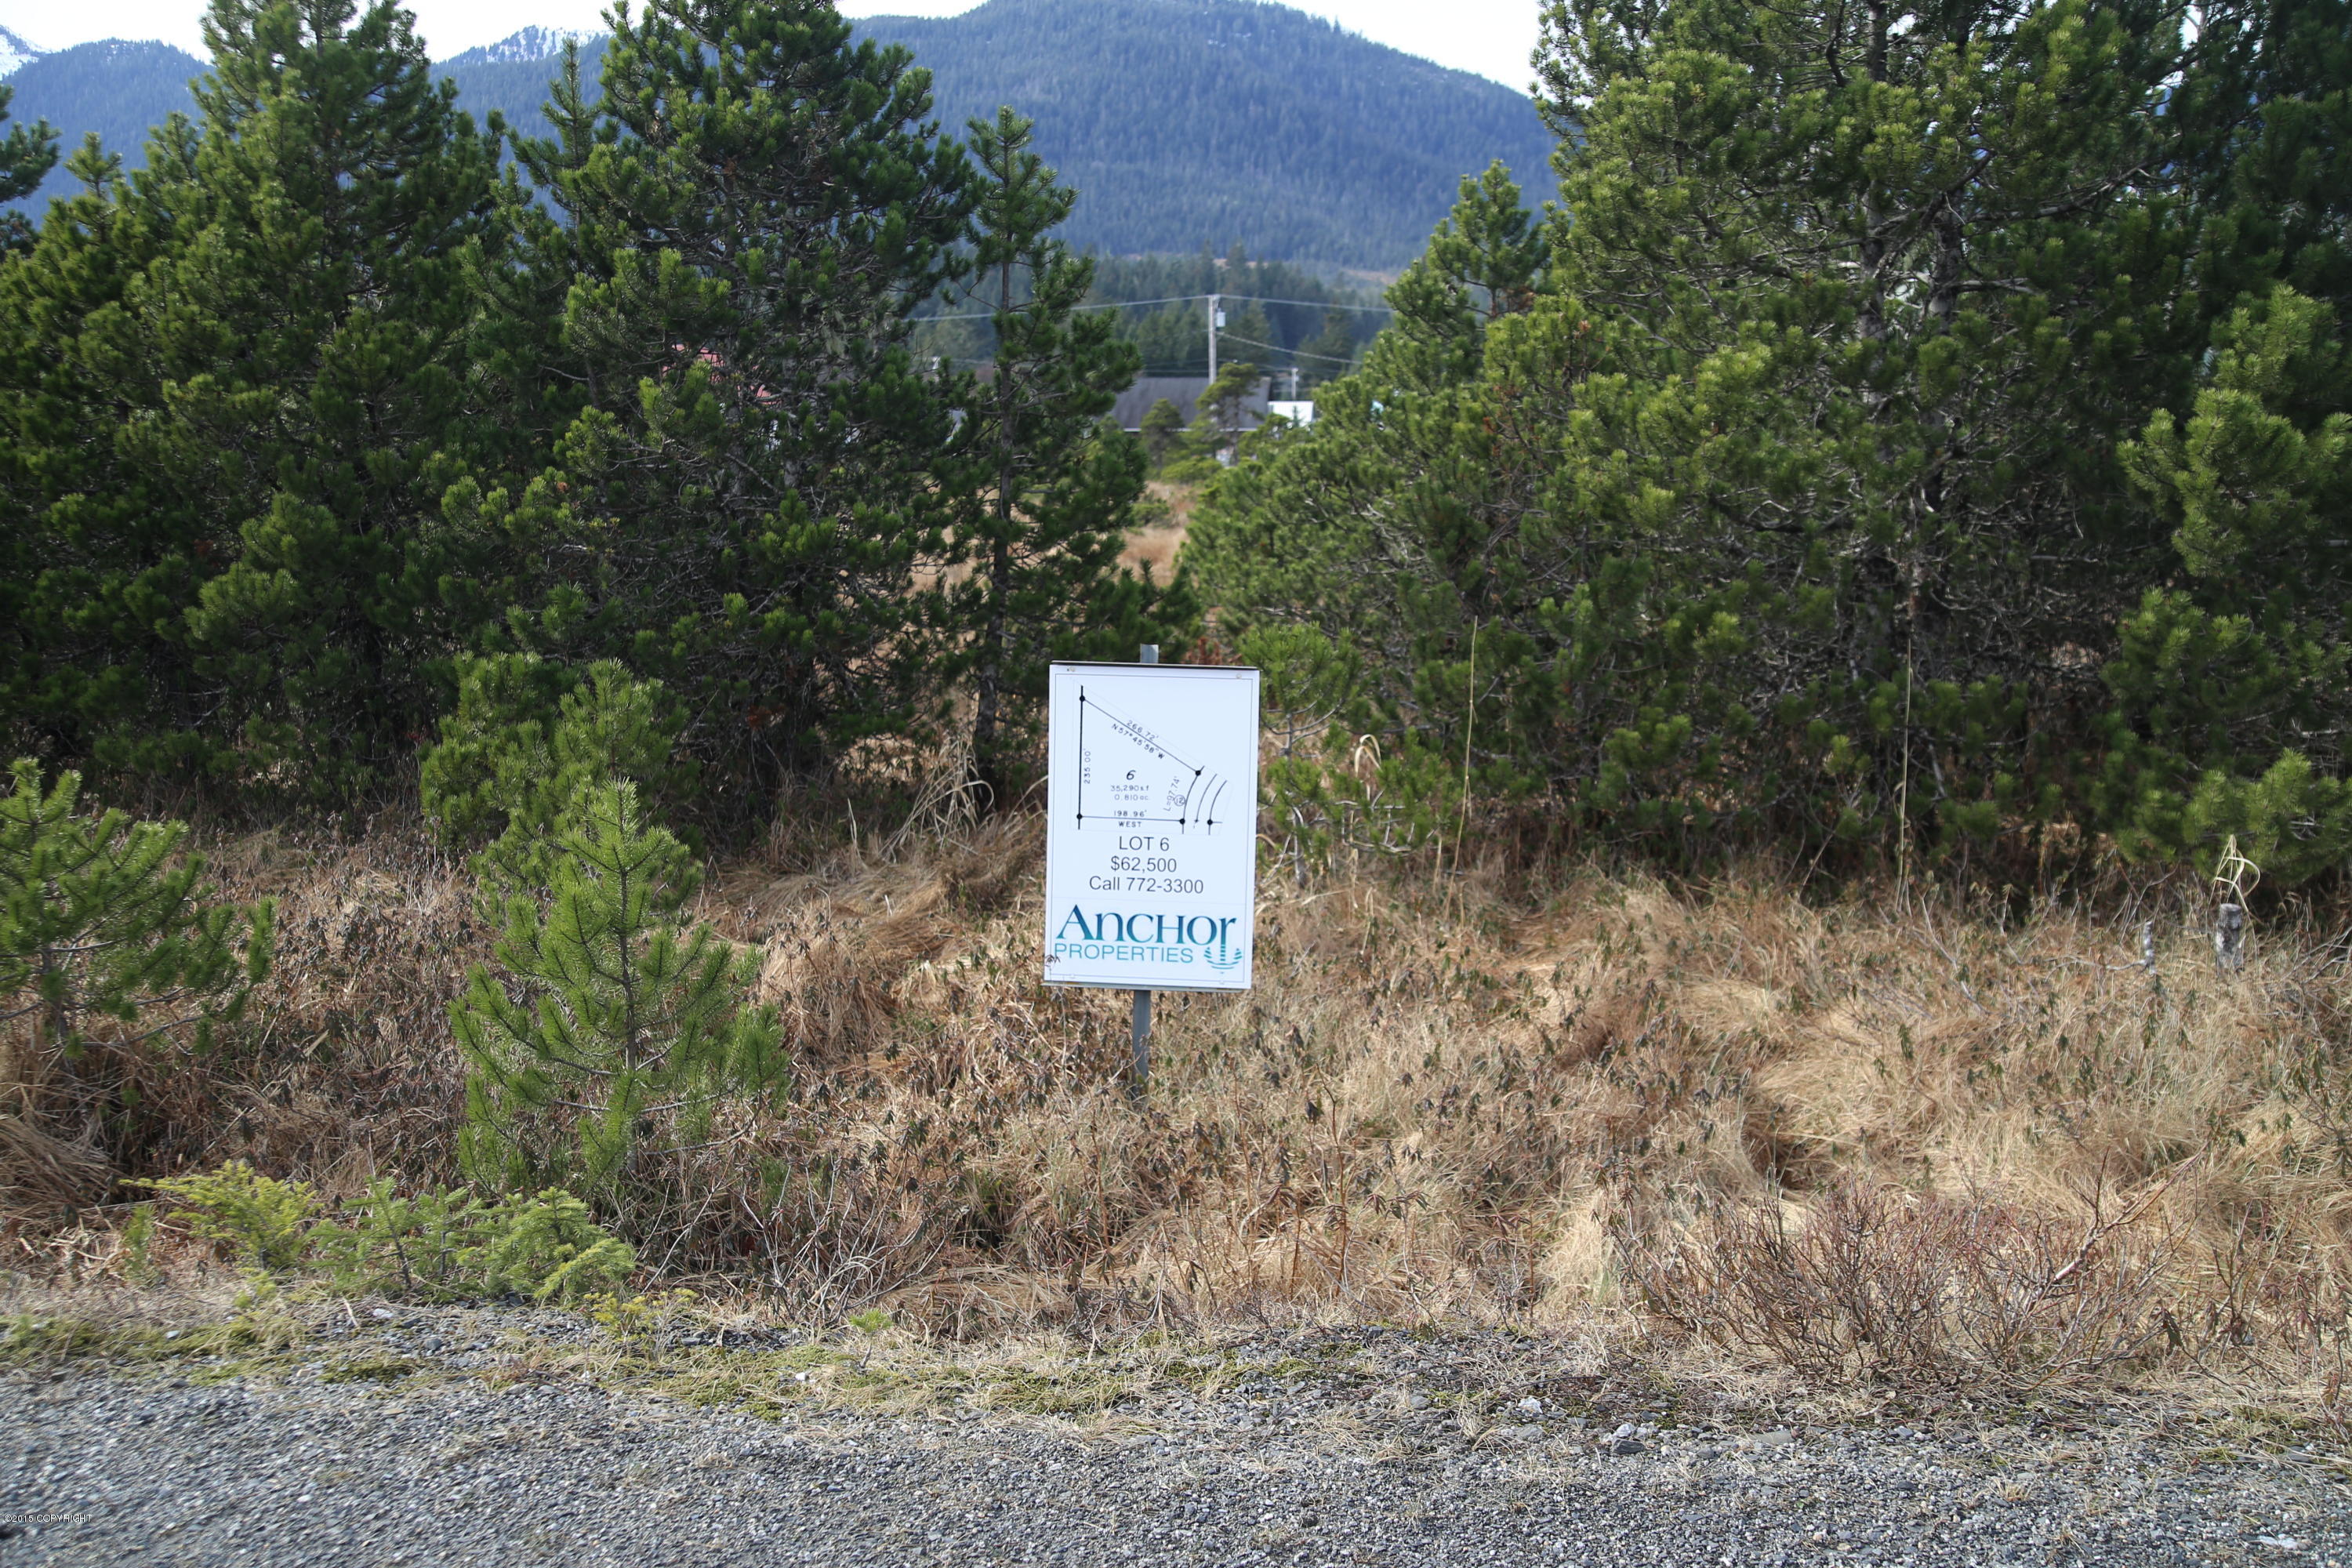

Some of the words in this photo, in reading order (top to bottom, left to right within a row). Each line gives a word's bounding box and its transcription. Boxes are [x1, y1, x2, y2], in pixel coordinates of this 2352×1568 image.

[1126, 769, 1136, 781] 6
[1118, 820, 1142, 829] WEST
[1119, 836, 1154, 851] LOT
[1160, 837, 1170, 851] 6
[1110, 855, 1177, 873] $62,500
[1089, 875, 1120, 891] Call
[1126, 877, 1204, 894] 772-3300
[1054, 943, 1194, 964] PROPERTIES
